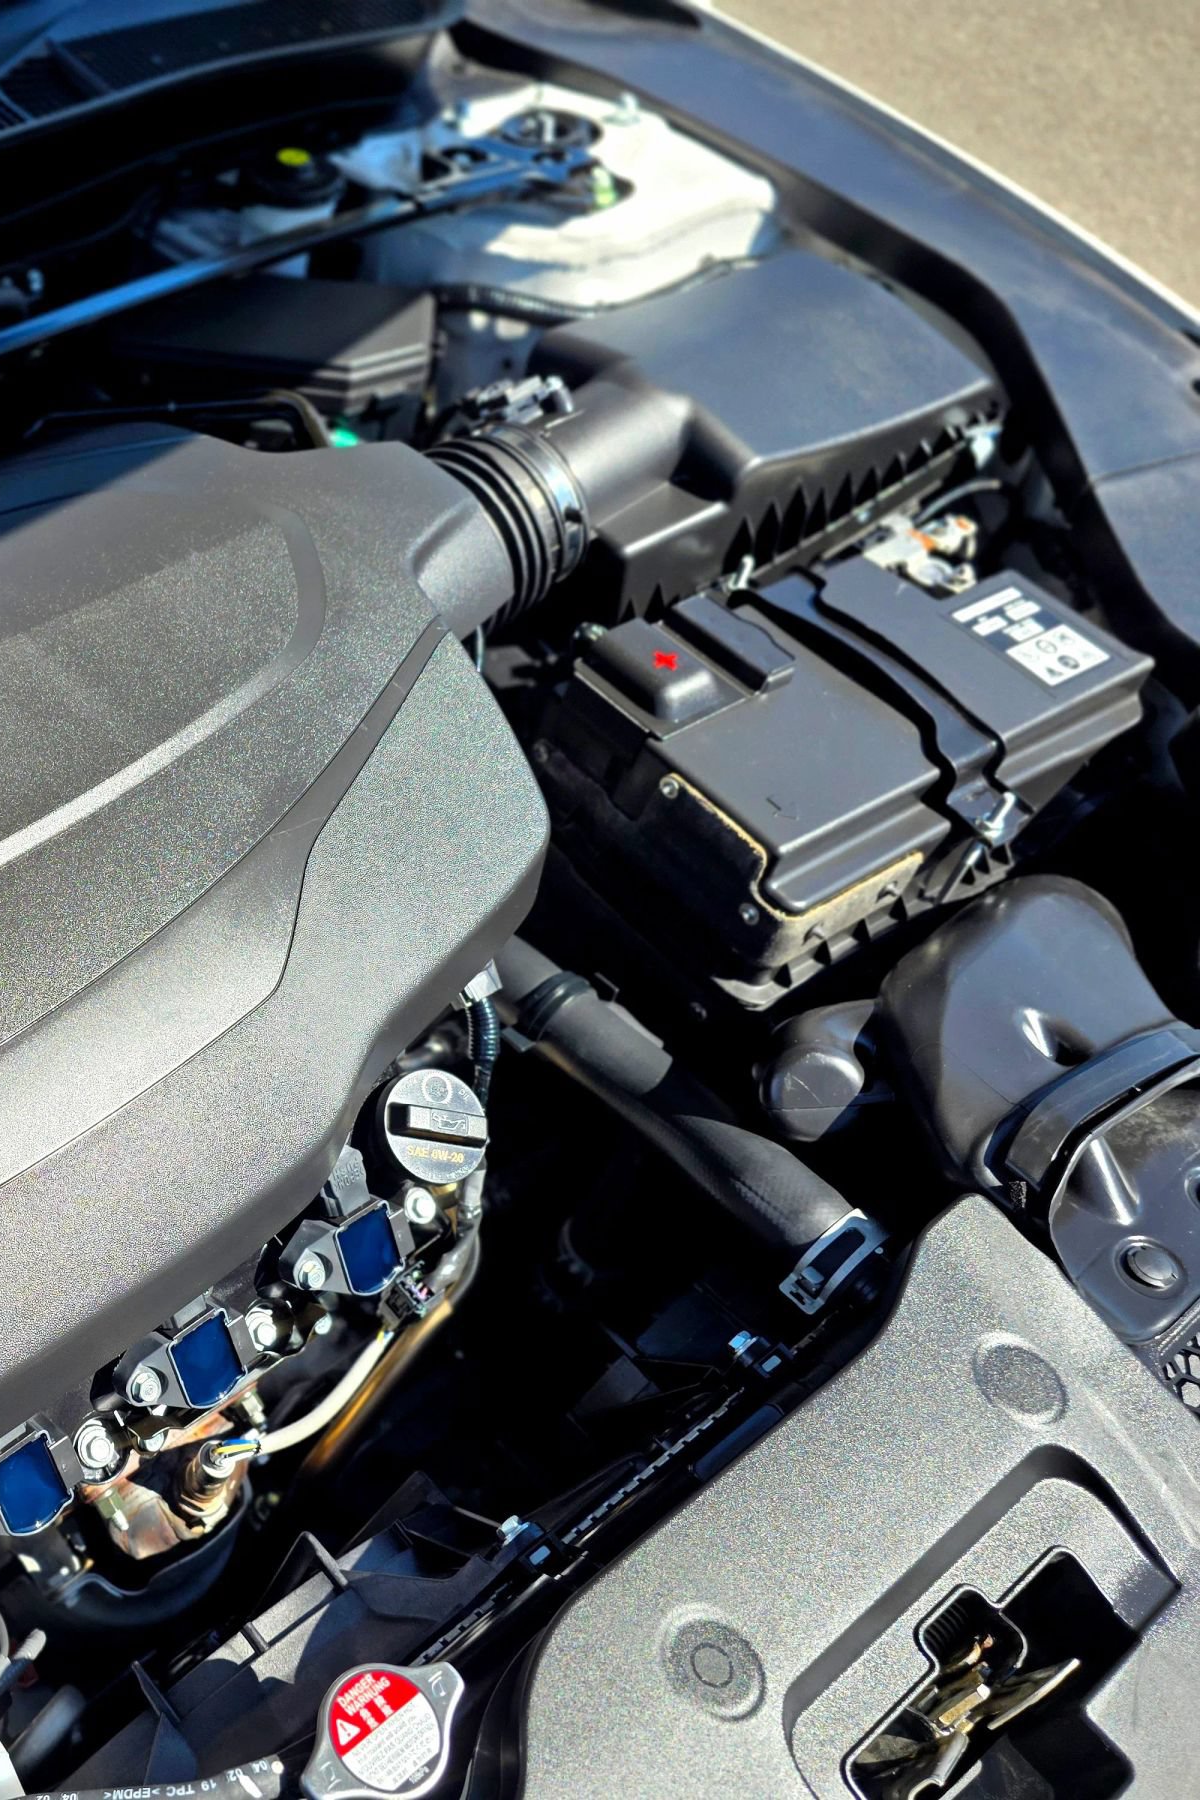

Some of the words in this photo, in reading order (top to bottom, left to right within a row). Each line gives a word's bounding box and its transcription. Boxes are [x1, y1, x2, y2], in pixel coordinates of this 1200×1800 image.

[407, 1145, 429, 1158] SAE
[431, 1150, 464, 1163] 0W-20
[337, 1673, 376, 1706] DANGER
[346, 1676, 391, 1716] WARNUNG
[252, 1761, 268, 1774] 04
[166, 1784, 195, 1797] TPC
[201, 1779, 217, 1791] 19
[103, 1787, 161, 1800] >EPDM<
